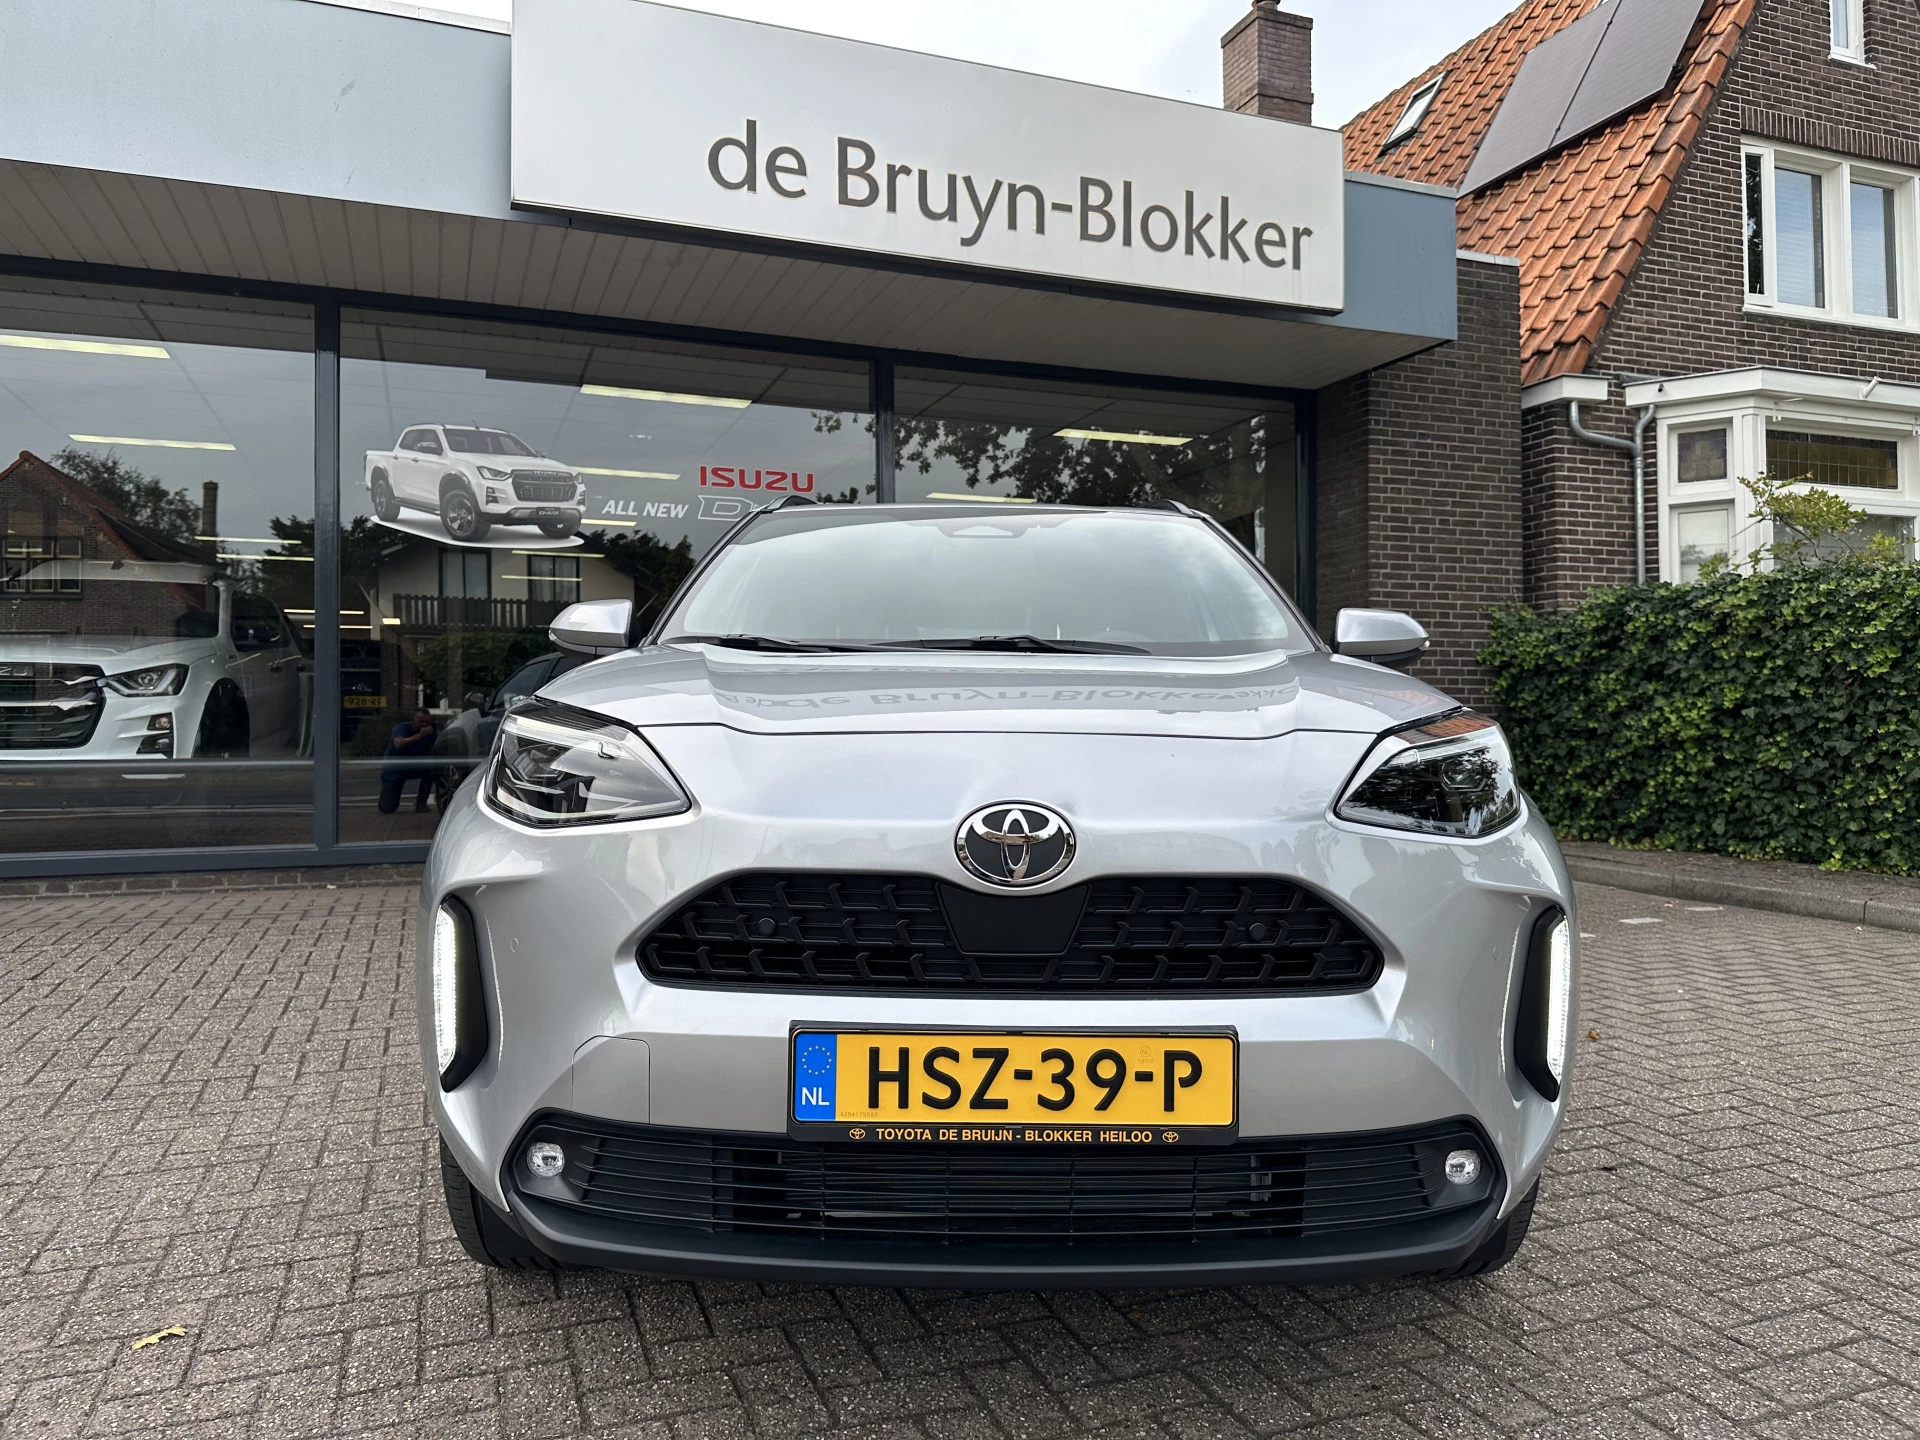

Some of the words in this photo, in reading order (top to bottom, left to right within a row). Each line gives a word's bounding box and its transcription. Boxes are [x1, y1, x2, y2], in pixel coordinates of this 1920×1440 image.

[707, 118, 808, 198] de
[836, 136, 1314, 271] Bruyn-Blokker
[699, 465, 815, 493] ISUZU
[602, 499, 638, 517] ALL
[642, 502, 690, 519] NEW
[867, 1046, 1203, 1113] HSZ-39-P
[801, 1086, 830, 1107] NL
[875, 1128, 932, 1141] TOYOTA
[939, 1129, 958, 1141] DE
[961, 1129, 1013, 1141] BRUIJN
[1025, 1129, 1093, 1142] BLOKKER
[1099, 1130, 1153, 1143] HEILOO
